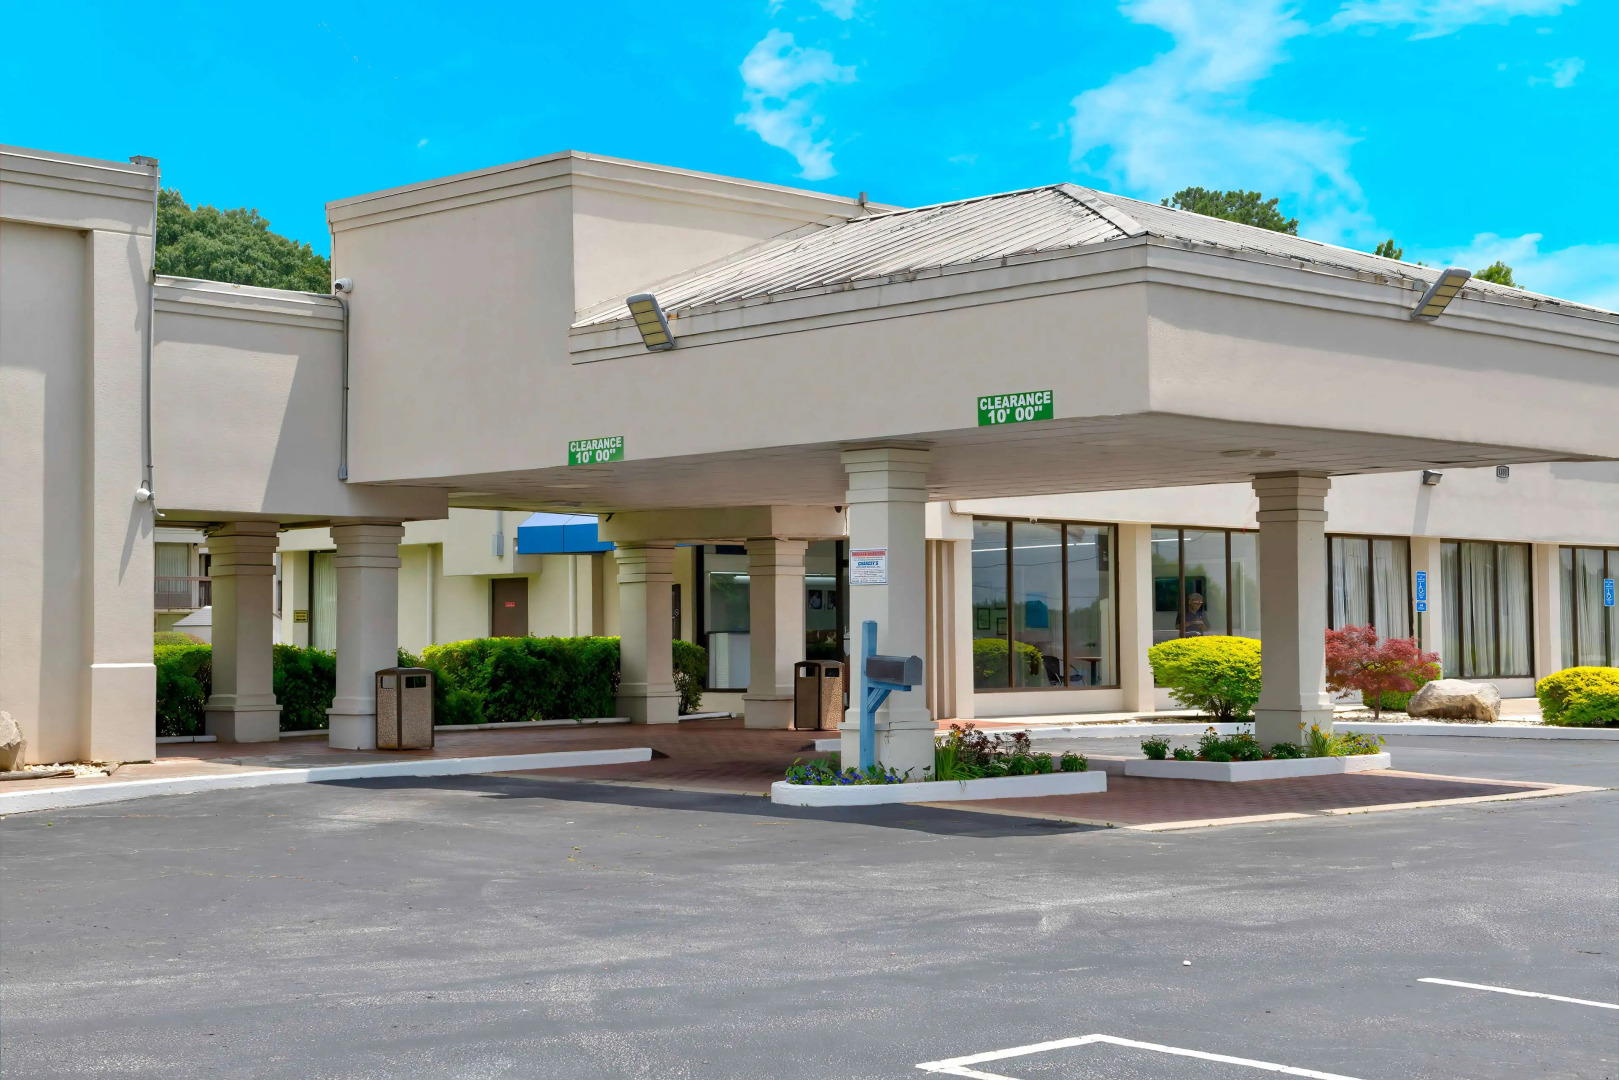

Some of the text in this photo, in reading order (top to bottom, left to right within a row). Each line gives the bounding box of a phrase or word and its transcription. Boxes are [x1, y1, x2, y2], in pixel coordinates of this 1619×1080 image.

[980, 392, 1051, 410] CLEARANCE
[988, 405, 1043, 424] 10' 00"
[570, 437, 621, 452] CLEARANCE
[576, 448, 616, 463] 10' 00"
